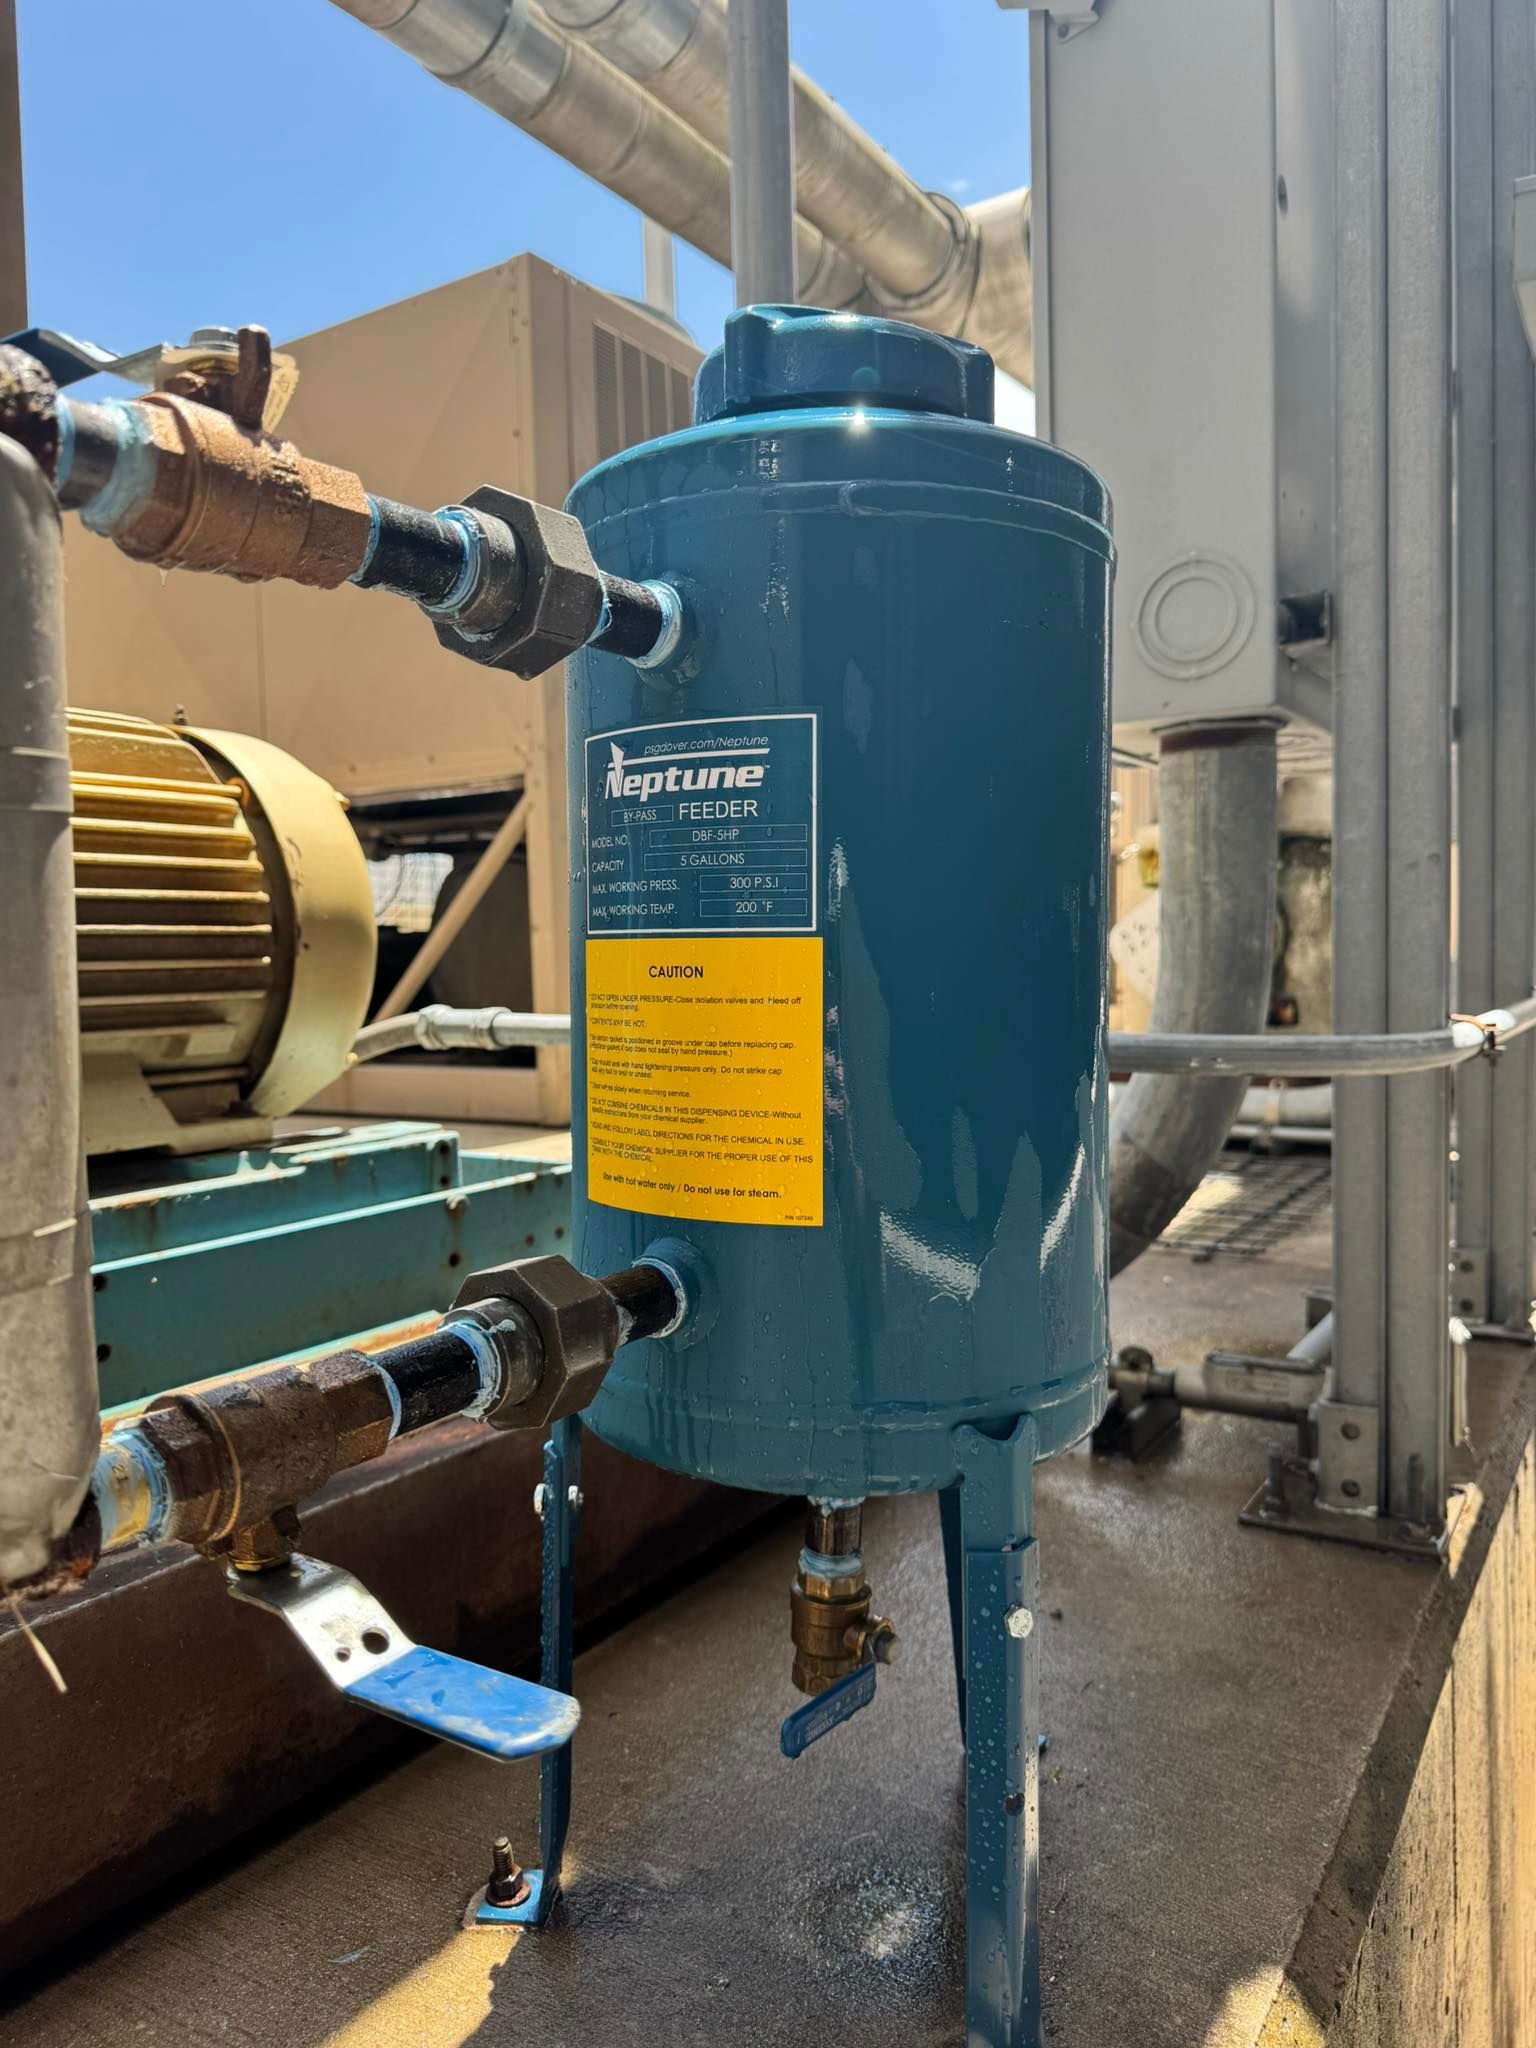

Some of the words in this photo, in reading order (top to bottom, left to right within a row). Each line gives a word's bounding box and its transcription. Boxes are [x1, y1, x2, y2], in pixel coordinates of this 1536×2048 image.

[643, 735, 769, 755] psgdover.com/Neptune
[604, 741, 764, 802] Neptune
[623, 810, 657, 823] BY-PASS
[679, 800, 758, 820] FEEDER
[592, 836, 613, 849] MODEL
[692, 829, 740, 842] DBF-5HP
[592, 860, 624, 872] CAPACITY
[680, 855, 687, 866] 5
[689, 853, 745, 866] GALLONS
[609, 880, 648, 893] WORKING
[649, 879, 680, 891] PRESS.
[730, 877, 751, 889] 300
[609, 904, 648, 916] WORKING
[649, 903, 678, 915] TEMP.
[736, 901, 757, 913] 200
[648, 965, 704, 978] CAUTION
[620, 994, 639, 1002] UNDER
[624, 1019, 632, 1027] BE
[662, 1039, 683, 1047] groove
[684, 1039, 703, 1047] under
[719, 1040, 742, 1048] before
[743, 1041, 778, 1049] replacing
[671, 1048, 679, 1056] by
[673, 1065, 701, 1073] pressure
[720, 1066, 731, 1074] Do
[746, 1067, 767, 1075] strike
[768, 1068, 782, 1076] cap
[629, 1102, 663, 1113] CHEMICALS
[673, 1106, 689, 1115] THIS
[690, 1107, 737, 1117] DISPENSING
[738, 1109, 801, 1119] DEVICE-Without
[653, 1113, 679, 1122] chemical
[633, 1128, 652, 1137] LABEL
[653, 1130, 694, 1141] DIRECTIONS
[695, 1133, 712, 1142] FOR
[712, 1134, 729, 1143] THE
[730, 1135, 773, 1145] CHEMICAL
[775, 1137, 784, 1145] IN
[655, 1147, 688, 1158] SUPPLIER
[689, 1150, 705, 1159] FOR
[707, 1151, 722, 1160] THE
[723, 1152, 758, 1161] PROPER
[760, 1153, 777, 1162] USE
[779, 1154, 792, 1163] OF
[793, 1155, 813, 1164] THIS
[613, 1174, 624, 1184] with
[637, 1179, 657, 1189] water
[658, 1181, 675, 1193] only
[683, 1184, 696, 1193] Do
[697, 1186, 713, 1195] not
[714, 1188, 730, 1196] use
[732, 1187, 745, 1197] for
[748, 1189, 782, 1199] steam.
